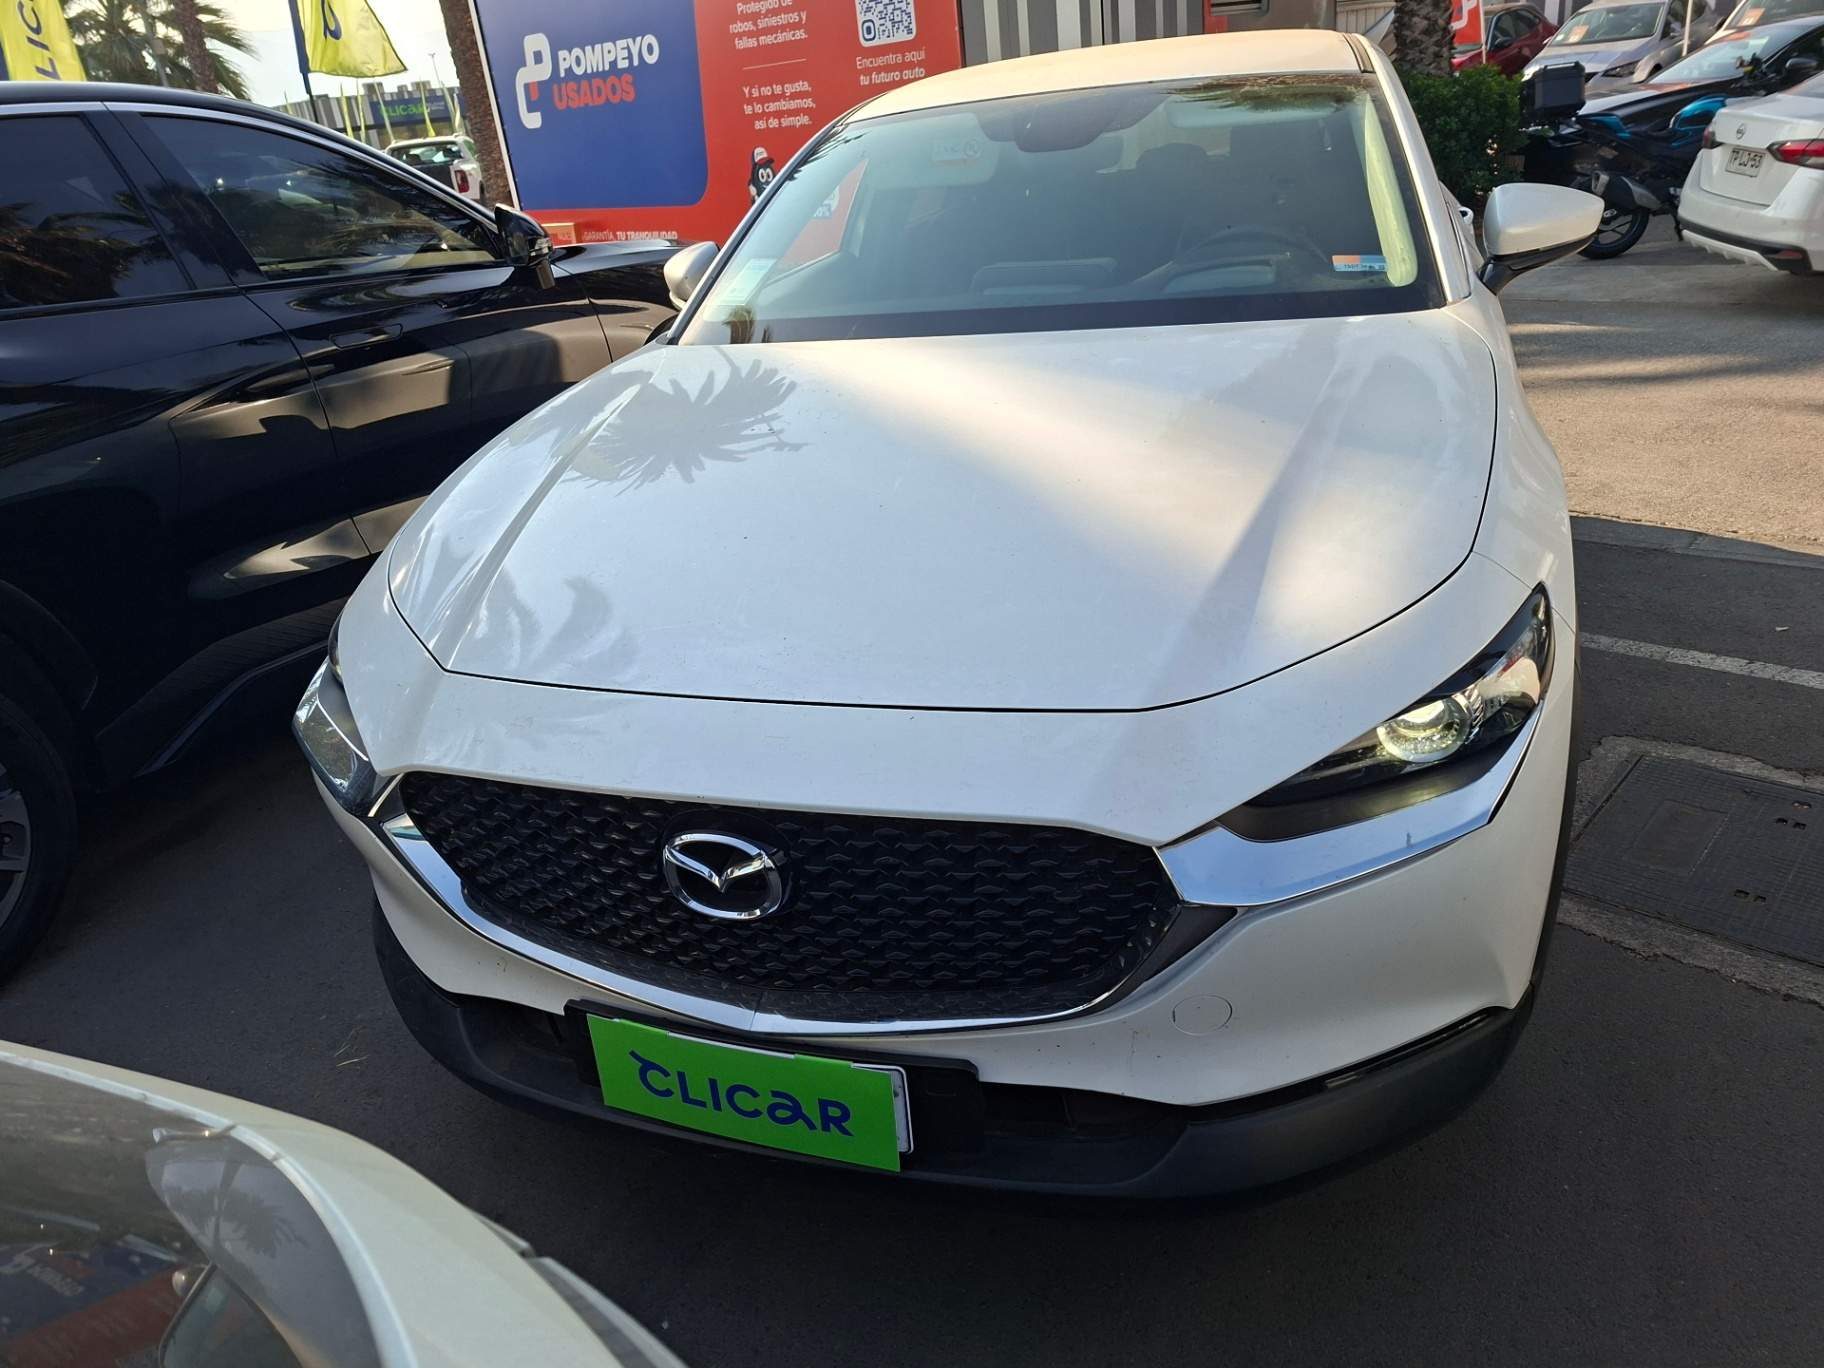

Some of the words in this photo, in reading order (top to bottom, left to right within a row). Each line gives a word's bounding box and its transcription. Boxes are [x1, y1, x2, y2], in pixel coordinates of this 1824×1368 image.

[736, 0, 779, 15] Protegido
[729, 20, 756, 34] robos,
[757, 11, 799, 29] siniestros
[800, 10, 807, 24] y
[735, 36, 757, 50] fallas
[758, 28, 808, 45] mecánicas.
[558, 34, 660, 78] POMPEYO
[856, 53, 902, 69] Encuentra
[904, 46, 926, 64] aquí
[860, 74, 870, 86] tu
[871, 71, 901, 85] futuro
[902, 66, 926, 80] auto
[553, 73, 636, 110] USADOS
[742, 86, 750, 98] Y
[751, 85, 759, 98] si
[760, 85, 772, 96] no
[772, 84, 782, 94] te
[783, 80, 812, 96] gusta,
[743, 104, 753, 114] te
[753, 101, 763, 113] lo
[764, 97, 816, 112] cambiamos,
[754, 116, 767, 130] así
[768, 117, 779, 128] de
[781, 113, 812, 128] simple.
[616, 231, 626, 241] TU
[627, 231, 678, 241] TRANQUILIDAD
